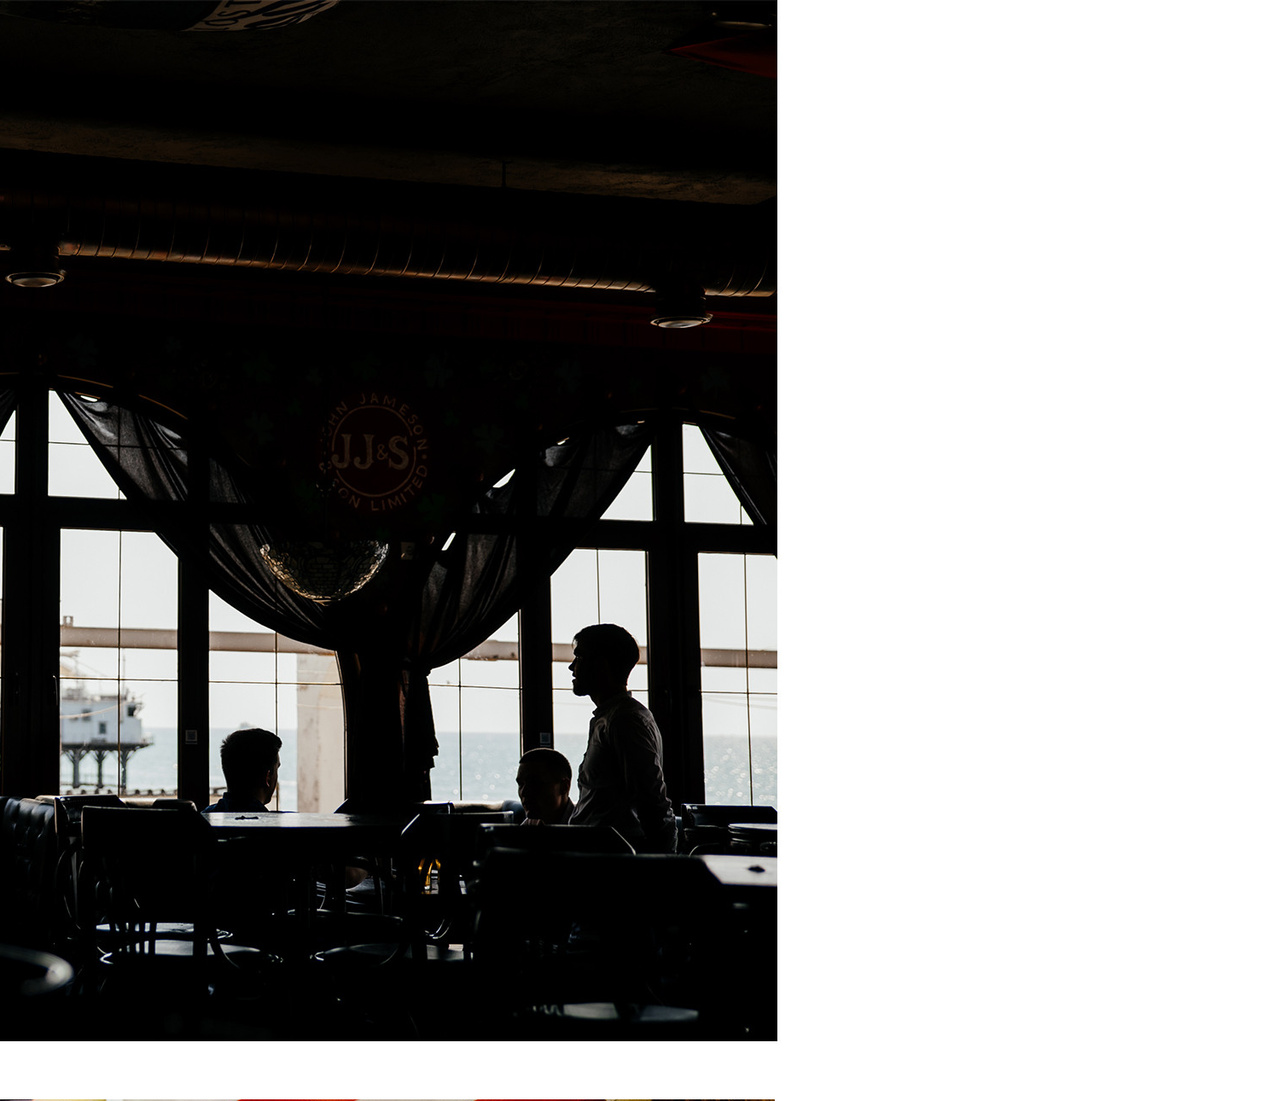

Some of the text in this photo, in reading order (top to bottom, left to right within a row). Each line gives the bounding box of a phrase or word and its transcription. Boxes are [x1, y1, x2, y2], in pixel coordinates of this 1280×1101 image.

[359, 391, 429, 451] JAMESON
[330, 433, 410, 471] JJ&S
[370, 464, 429, 511] LIMITED
